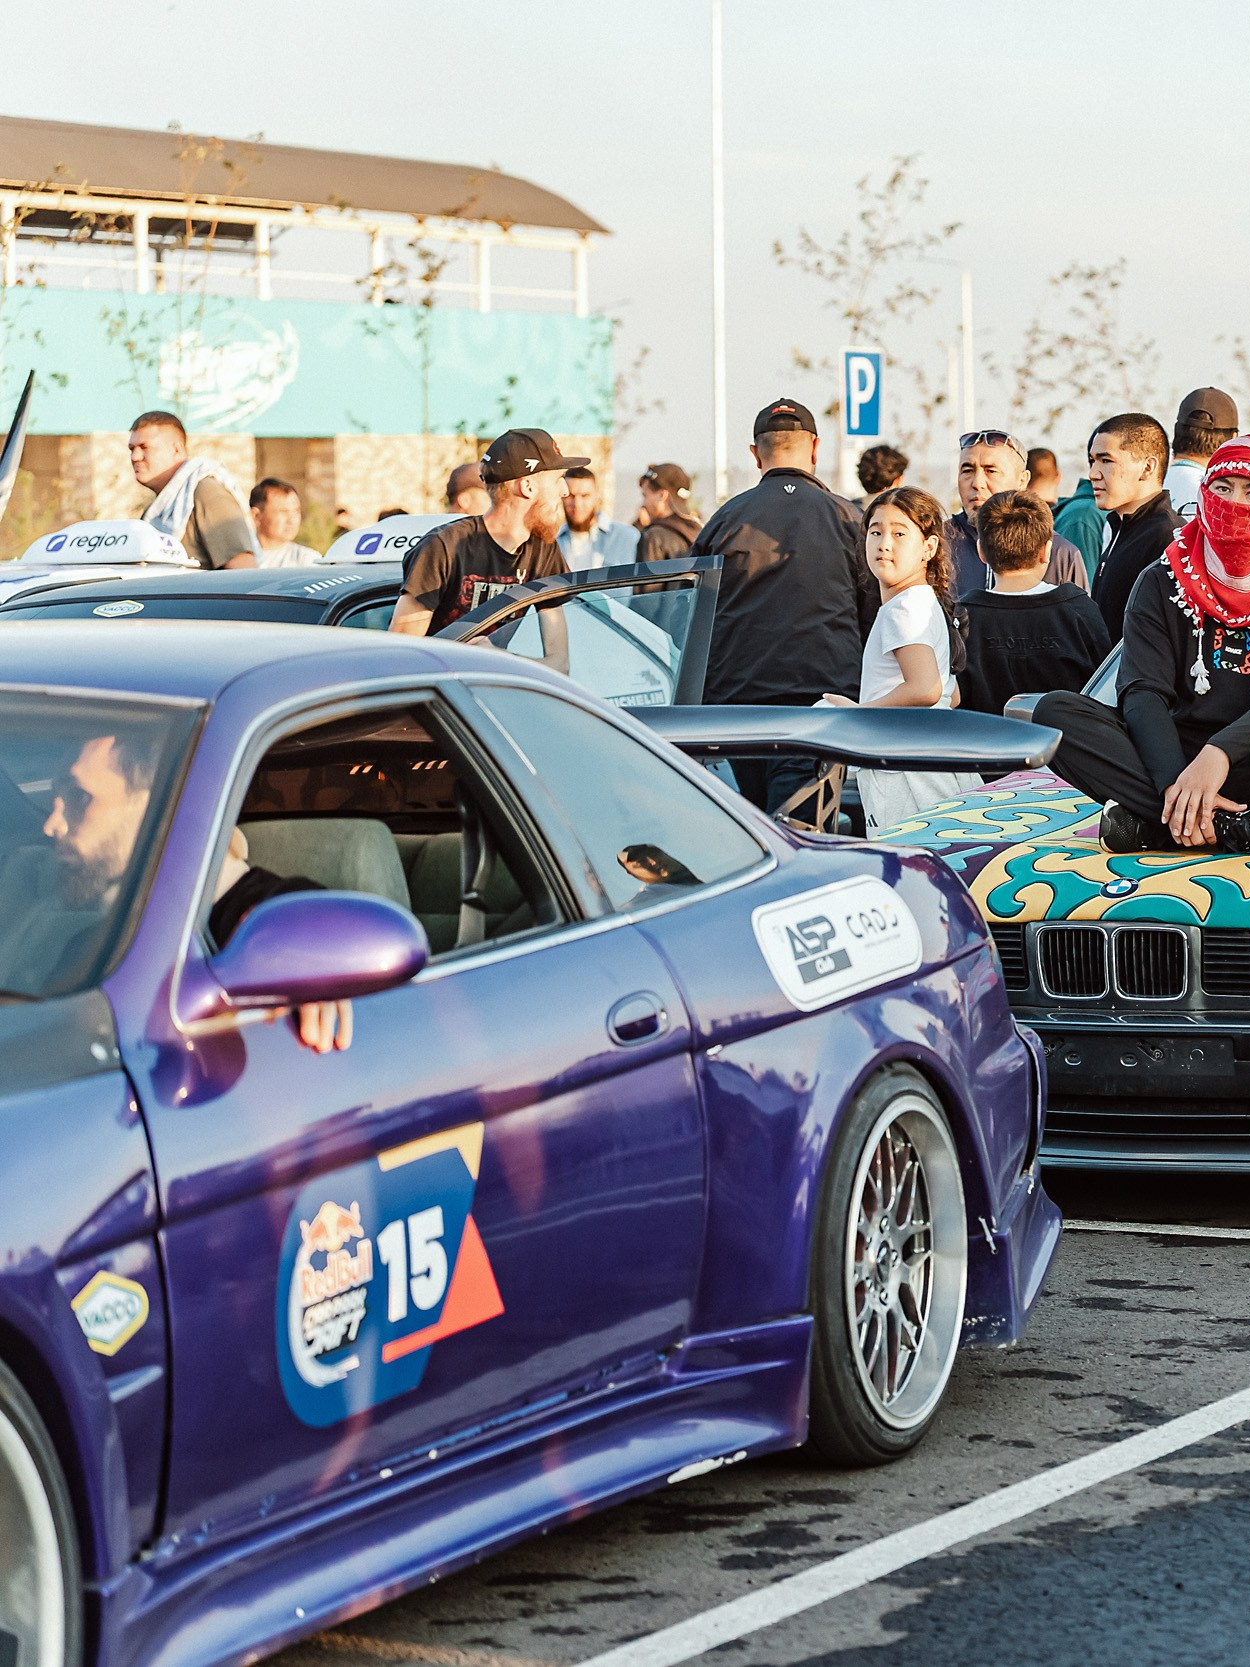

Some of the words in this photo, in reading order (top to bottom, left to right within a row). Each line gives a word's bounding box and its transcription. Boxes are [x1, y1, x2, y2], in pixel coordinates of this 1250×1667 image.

[848, 356, 877, 430] P
[69, 532, 129, 553] region
[377, 1205, 448, 1323] 15
